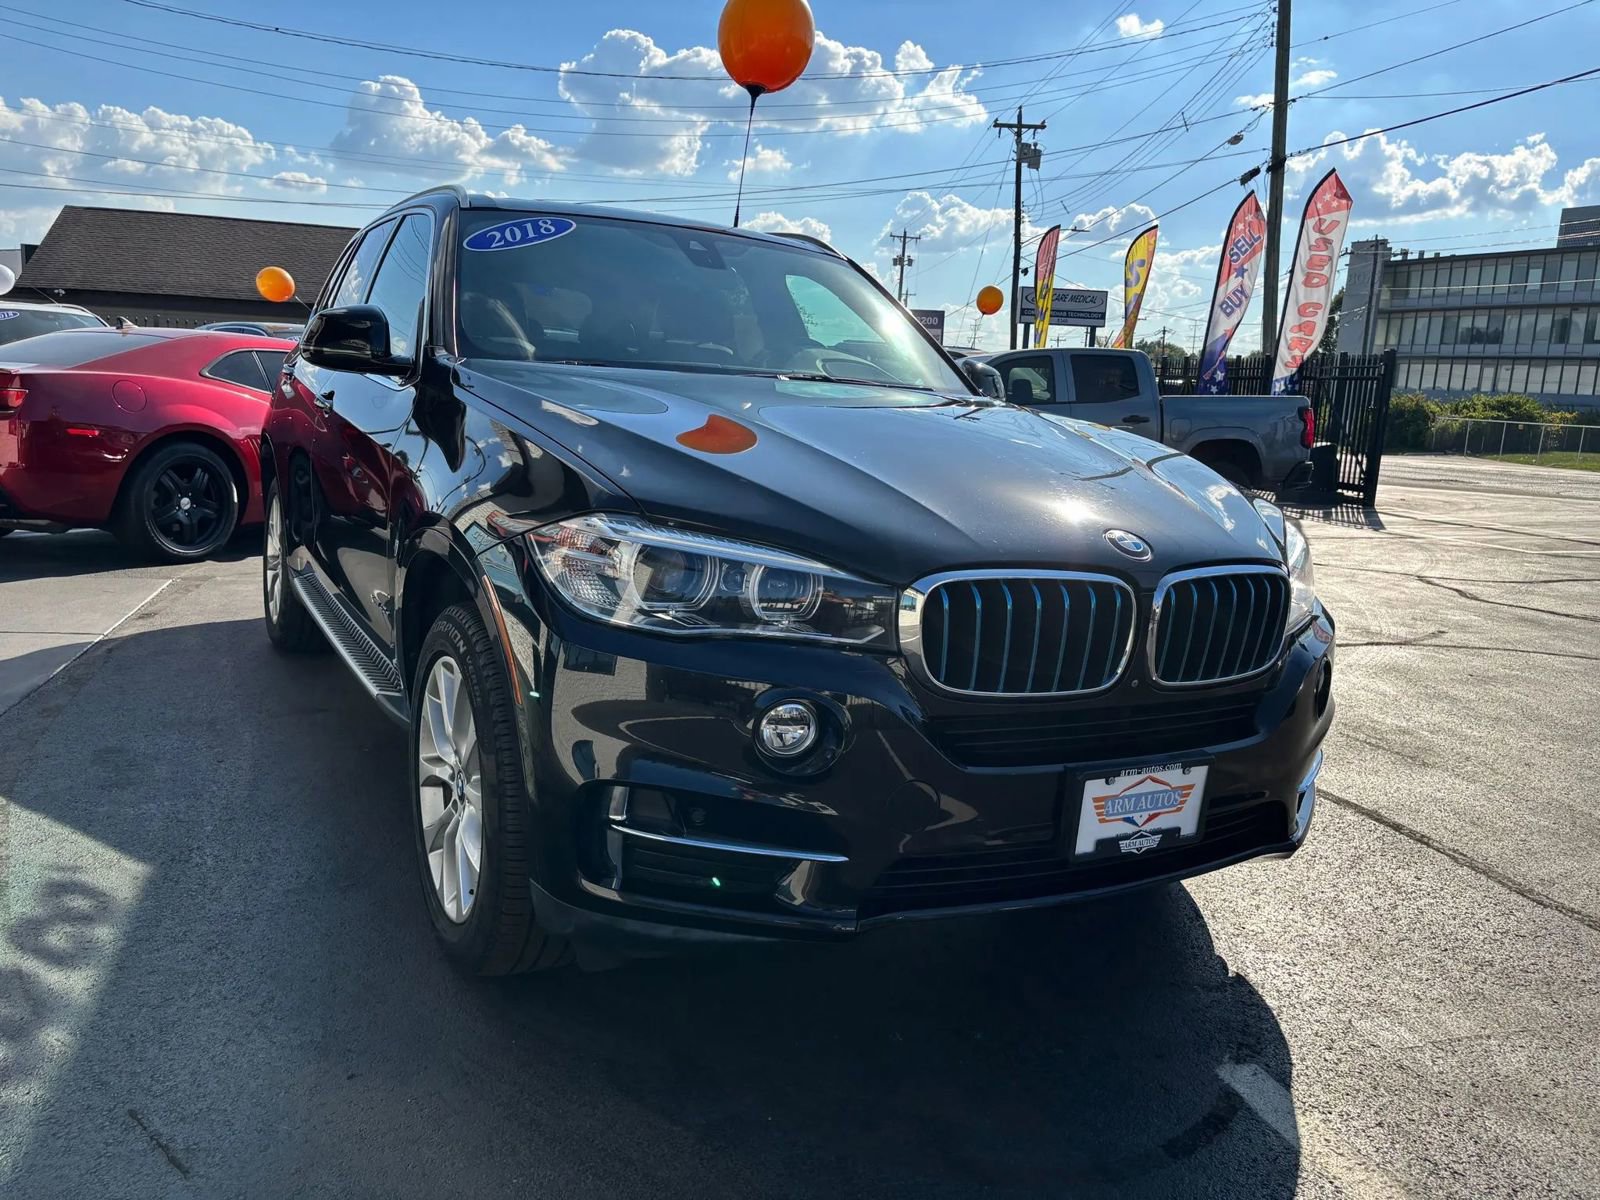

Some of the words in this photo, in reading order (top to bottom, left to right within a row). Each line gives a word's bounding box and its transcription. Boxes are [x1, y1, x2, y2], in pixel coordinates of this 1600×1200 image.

[486, 218, 555, 248] 2018
[1228, 227, 1262, 264] SELL
[1302, 217, 1340, 288] USED
[1068, 293, 1098, 304] MEDICAL
[1219, 285, 1250, 318] BUY
[1284, 302, 1324, 369] CARS
[1120, 763, 1182, 776] arm-autos.com
[1104, 798, 1135, 815] ARM
[1136, 790, 1182, 810] AUTOS
